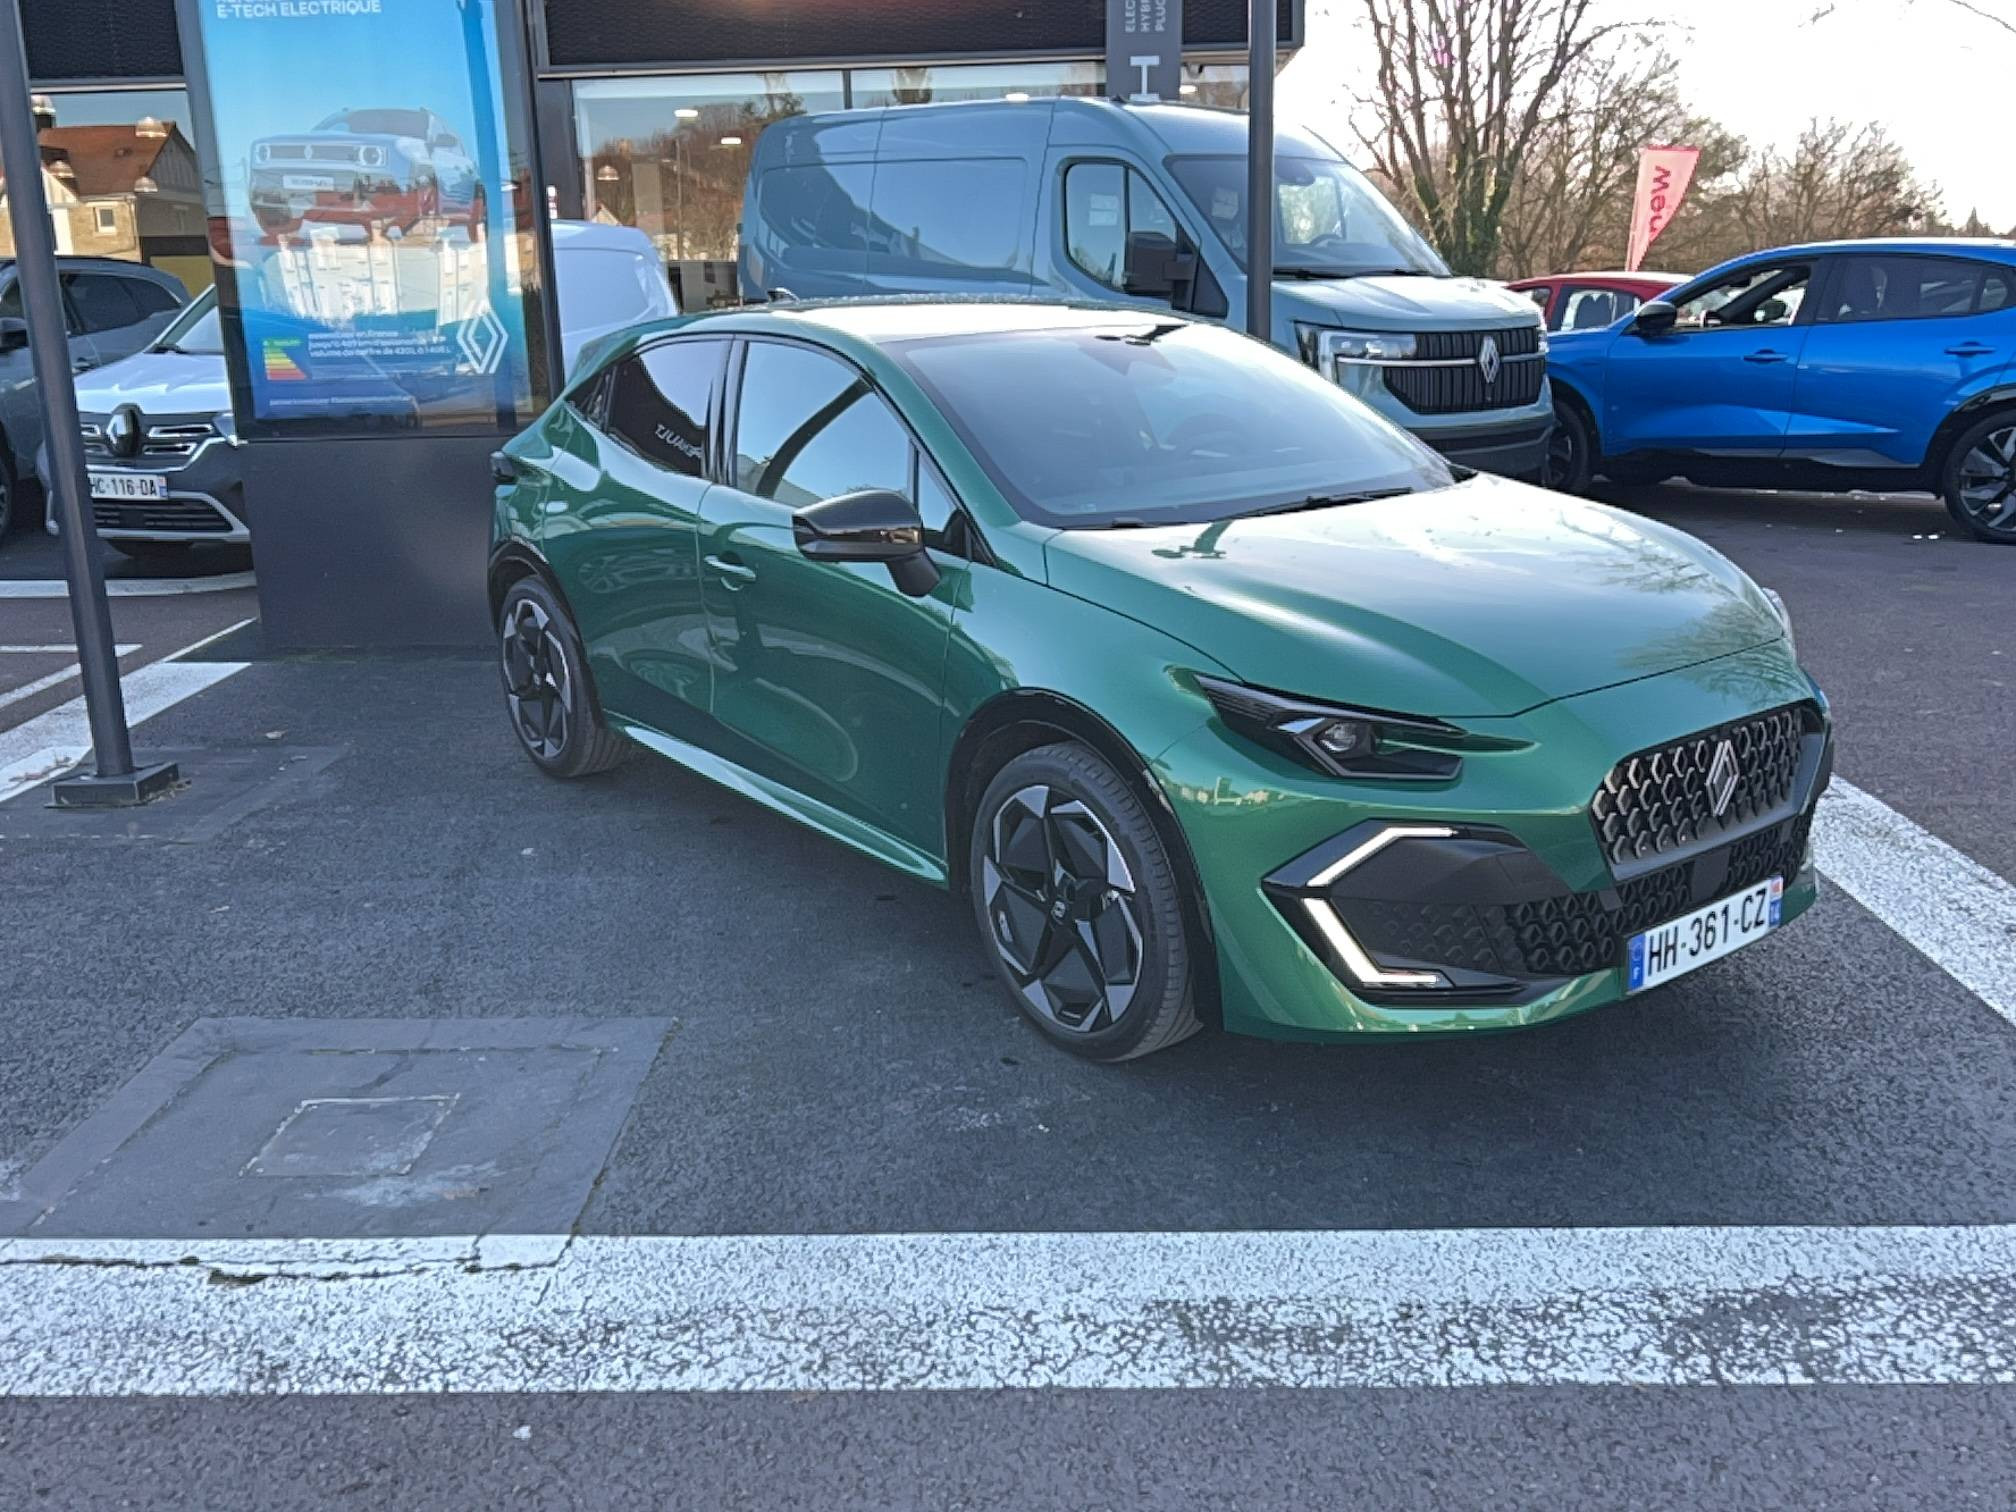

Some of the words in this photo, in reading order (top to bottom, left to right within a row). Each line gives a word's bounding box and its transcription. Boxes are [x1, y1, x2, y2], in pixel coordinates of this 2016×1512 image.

[216, 3, 278, 19] E-TECH
[280, 0, 382, 17] ELECTRIQUE
[1649, 165, 1671, 233] new
[1648, 888, 1767, 976] HH-361-CZ
